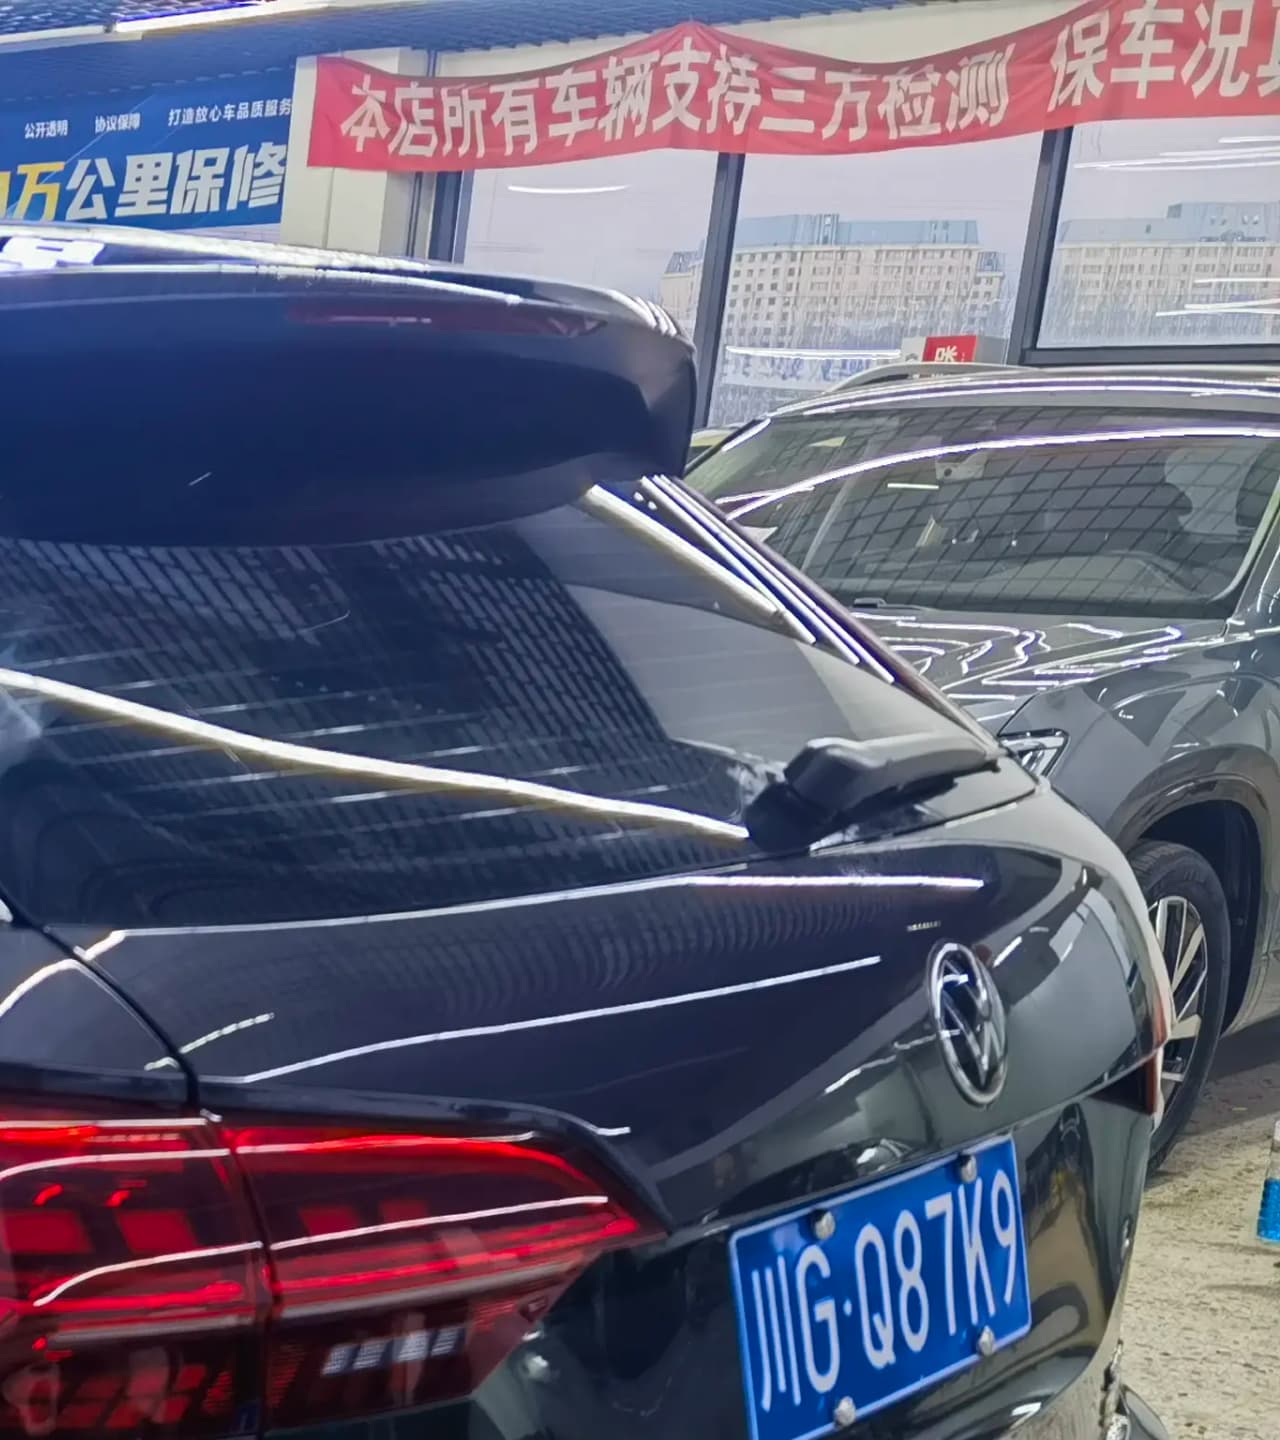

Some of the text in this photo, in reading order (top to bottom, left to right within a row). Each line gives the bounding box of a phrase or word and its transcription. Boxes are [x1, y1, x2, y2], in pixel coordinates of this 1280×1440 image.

[24, 119, 69, 140] 公开透明
[94, 112, 141, 133] 协议保障
[167, 97, 294, 128] 打造放心车品质服务
[340, 36, 1015, 158] 本店所有车辆支持三方检测
